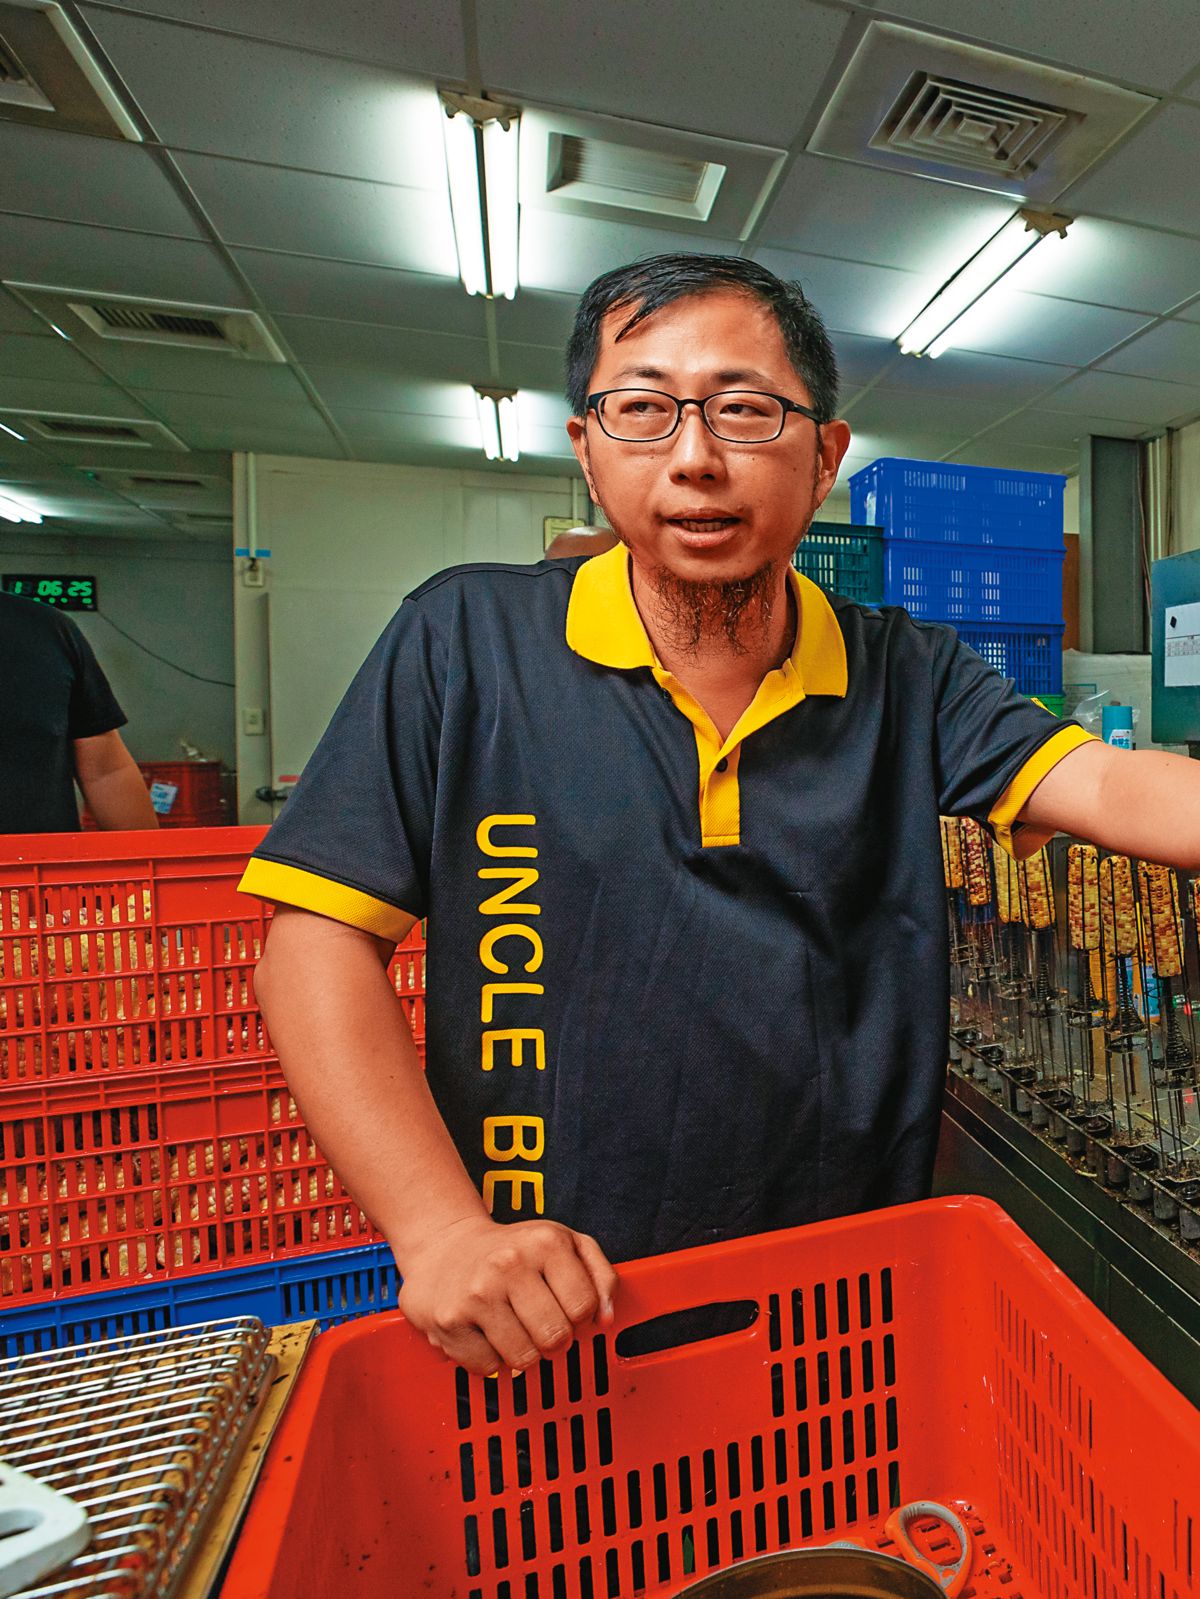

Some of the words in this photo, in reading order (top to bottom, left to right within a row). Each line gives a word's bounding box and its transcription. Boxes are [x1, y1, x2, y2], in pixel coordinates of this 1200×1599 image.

[37, 580, 63, 597] 06
[67, 580, 93, 597] 25
[475, 813, 547, 1071] UNCLE
